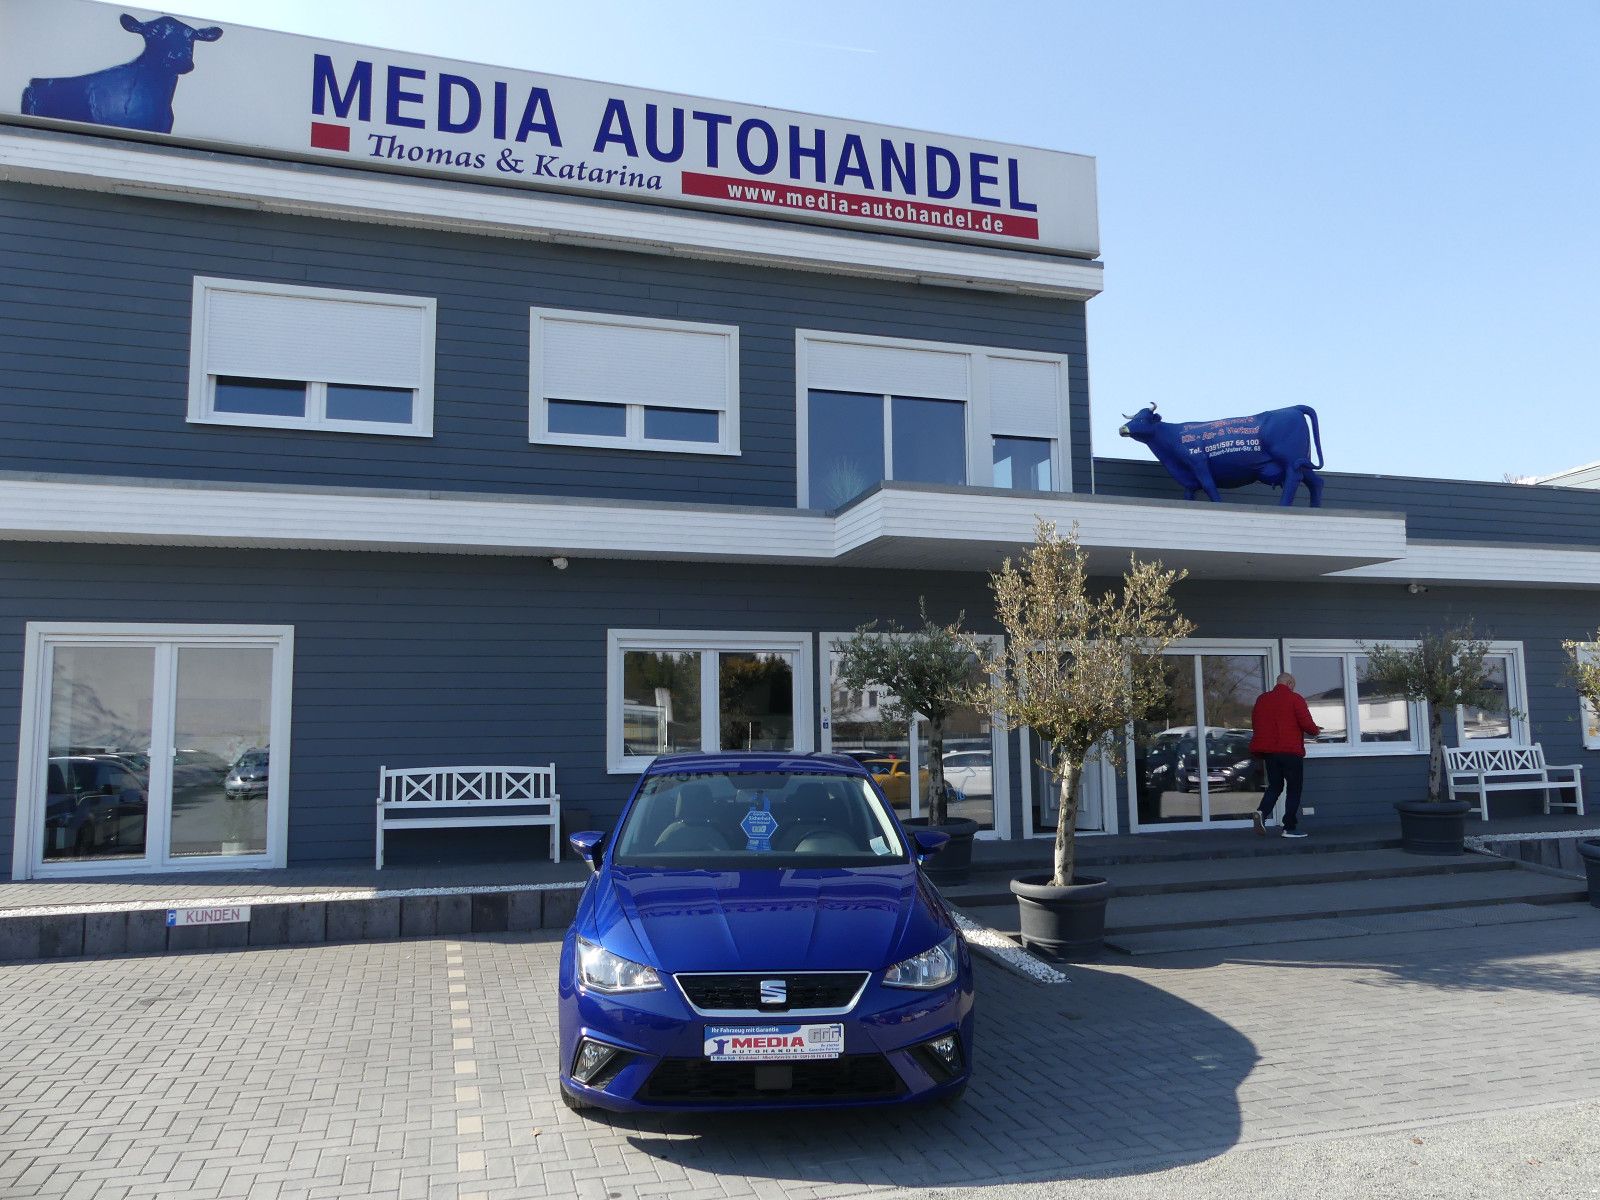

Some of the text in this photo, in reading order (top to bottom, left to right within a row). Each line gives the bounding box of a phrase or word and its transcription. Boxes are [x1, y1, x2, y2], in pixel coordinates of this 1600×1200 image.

[311, 53, 1038, 212] MEDIA AUTOHANDEL
[367, 133, 663, 190] Thomas & Katarina
[727, 183, 1004, 233] www.media-autohandel.de
[1246, 438, 1259, 446] 100
[168, 908, 240, 923] P KUNDEN
[731, 1038, 805, 1048] MEDIA
